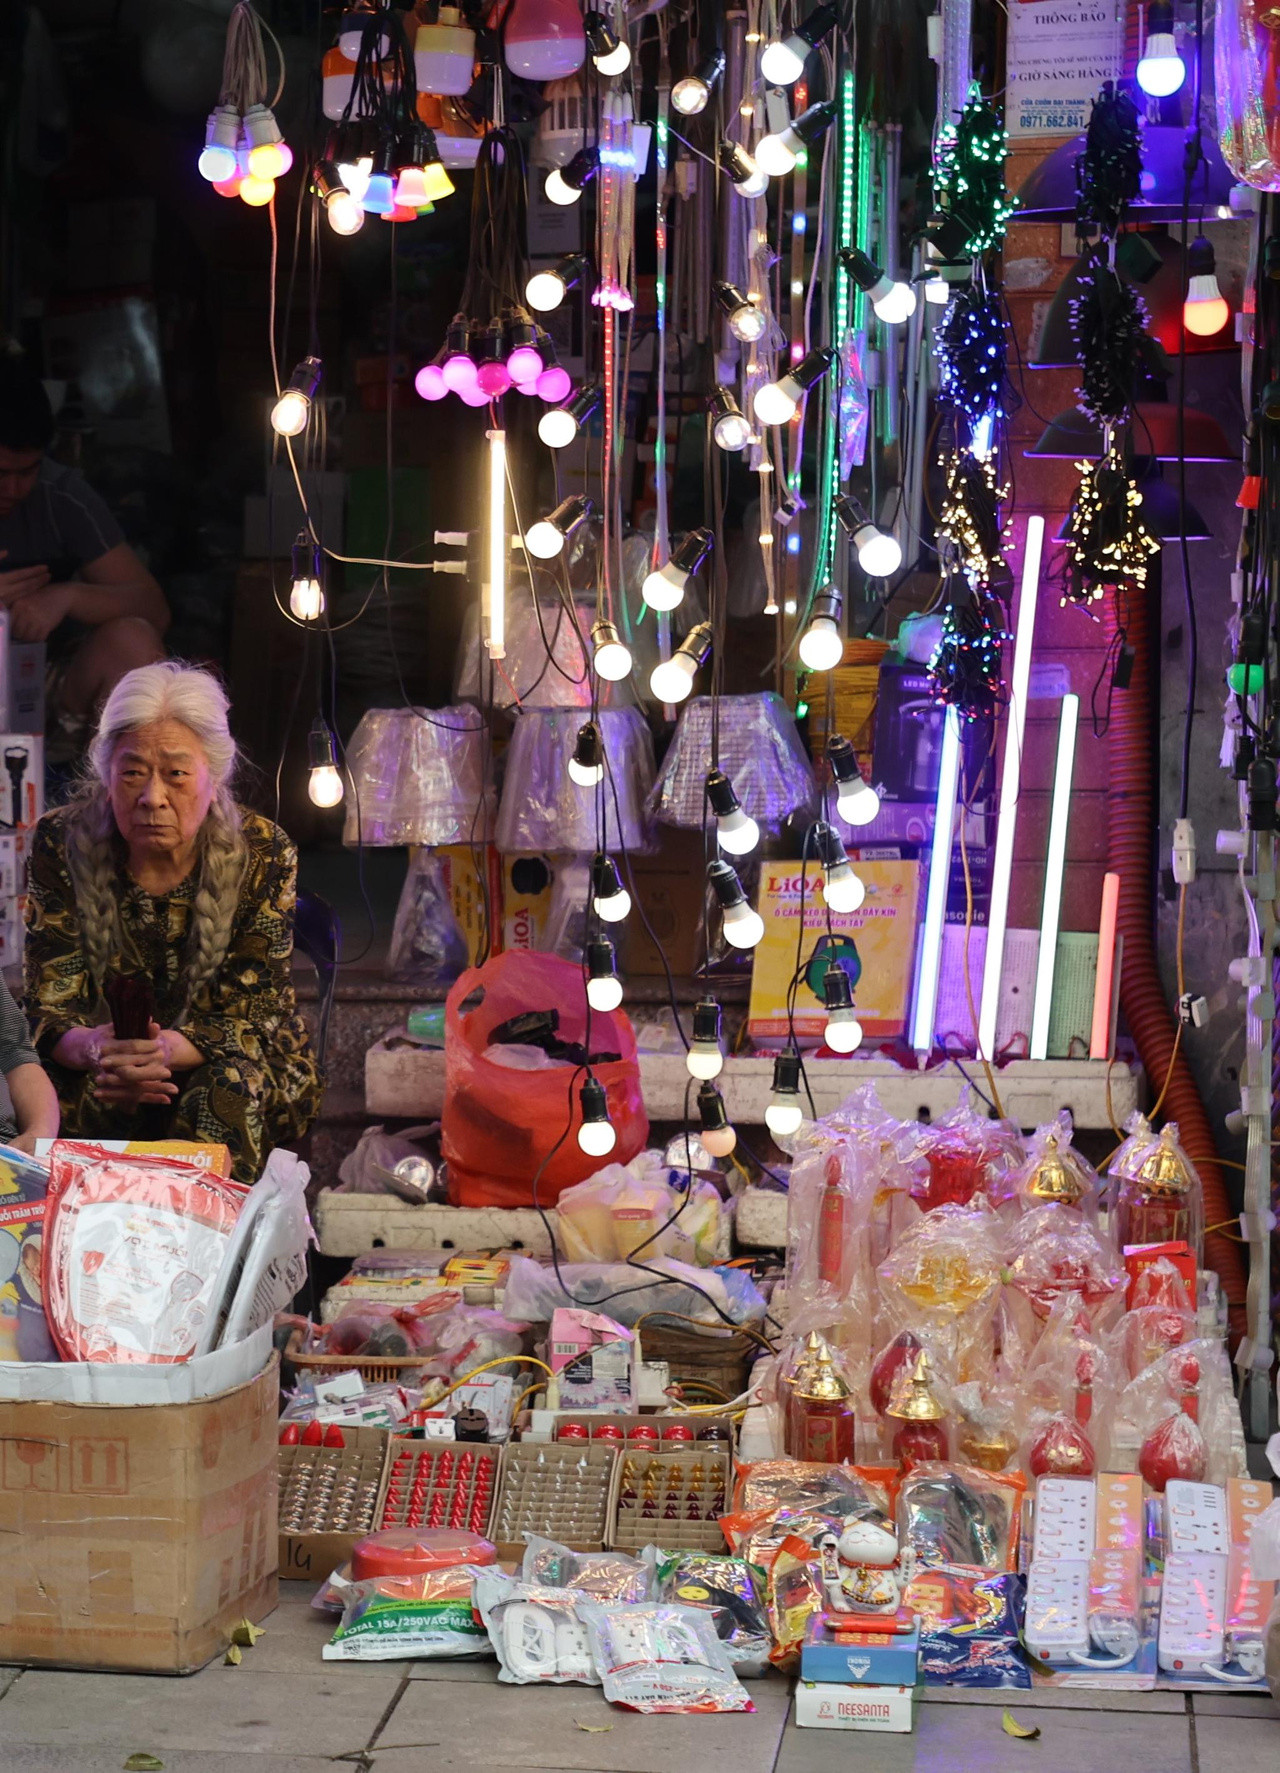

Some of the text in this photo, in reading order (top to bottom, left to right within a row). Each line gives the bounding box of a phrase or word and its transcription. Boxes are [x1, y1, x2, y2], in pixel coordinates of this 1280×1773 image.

[1034, 10, 1106, 24] THÔNG BÁO
[1019, 70, 1041, 81] GIỜ
[1043, 69, 1074, 80] SÁNG
[1078, 67, 1112, 78] HÀNG
[1020, 115, 1084, 128] 0971.662.841
[767, 877, 825, 893] LiOA
[344, 1621, 374, 1636] TOTAL
[377, 1616, 448, 1629] 15A/250VAC
[837, 1702, 890, 1717] NEESANTA
